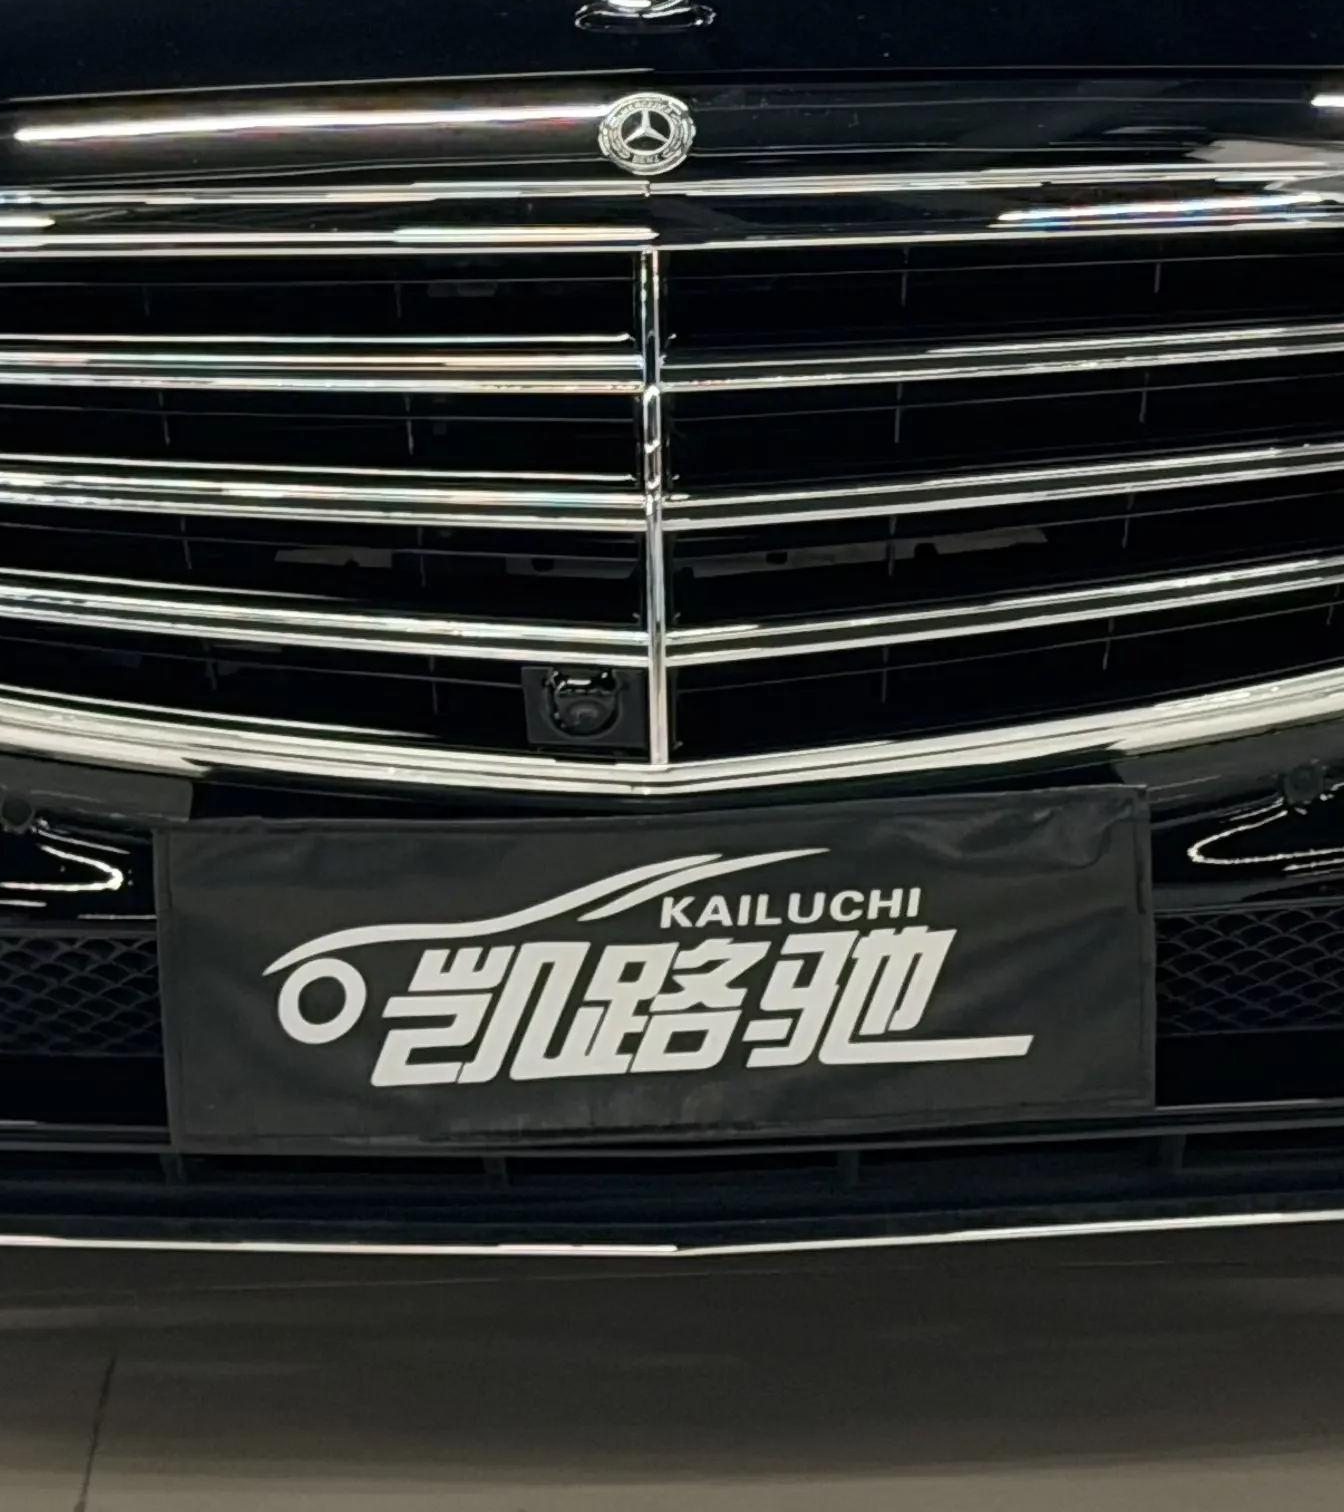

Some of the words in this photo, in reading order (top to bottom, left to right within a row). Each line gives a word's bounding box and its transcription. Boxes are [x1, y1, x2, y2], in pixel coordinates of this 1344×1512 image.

[660, 887, 921, 929] KAILUCHI
[370, 925, 1034, 1087] 凯路驰
